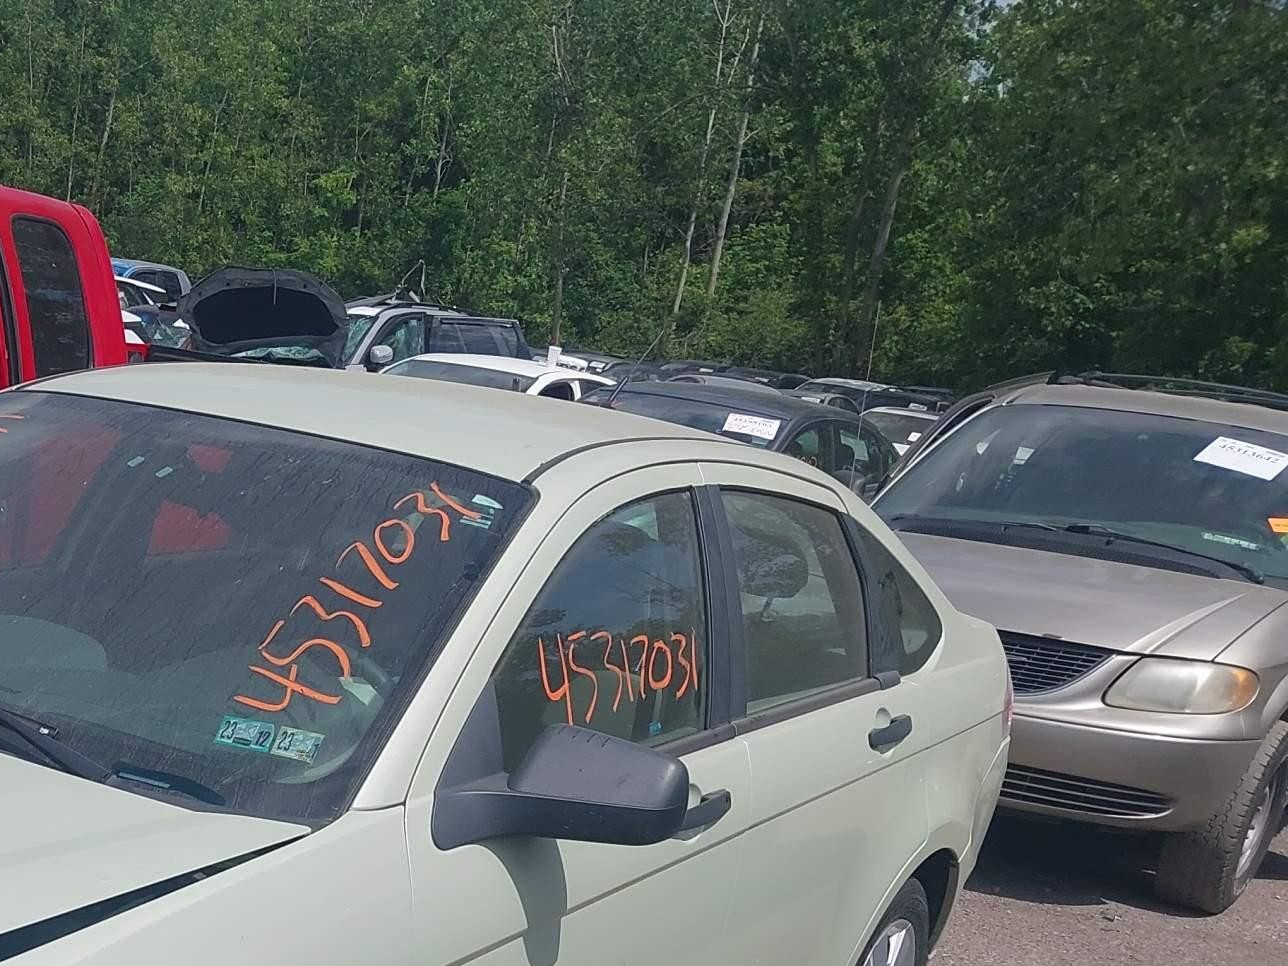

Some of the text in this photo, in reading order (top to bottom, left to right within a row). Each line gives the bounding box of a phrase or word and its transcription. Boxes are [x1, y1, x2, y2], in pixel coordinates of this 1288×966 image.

[233, 481, 481, 712] 45317031
[538, 625, 698, 726] 45317031
[220, 720, 272, 747] 23 12
[277, 731, 295, 751] 23
